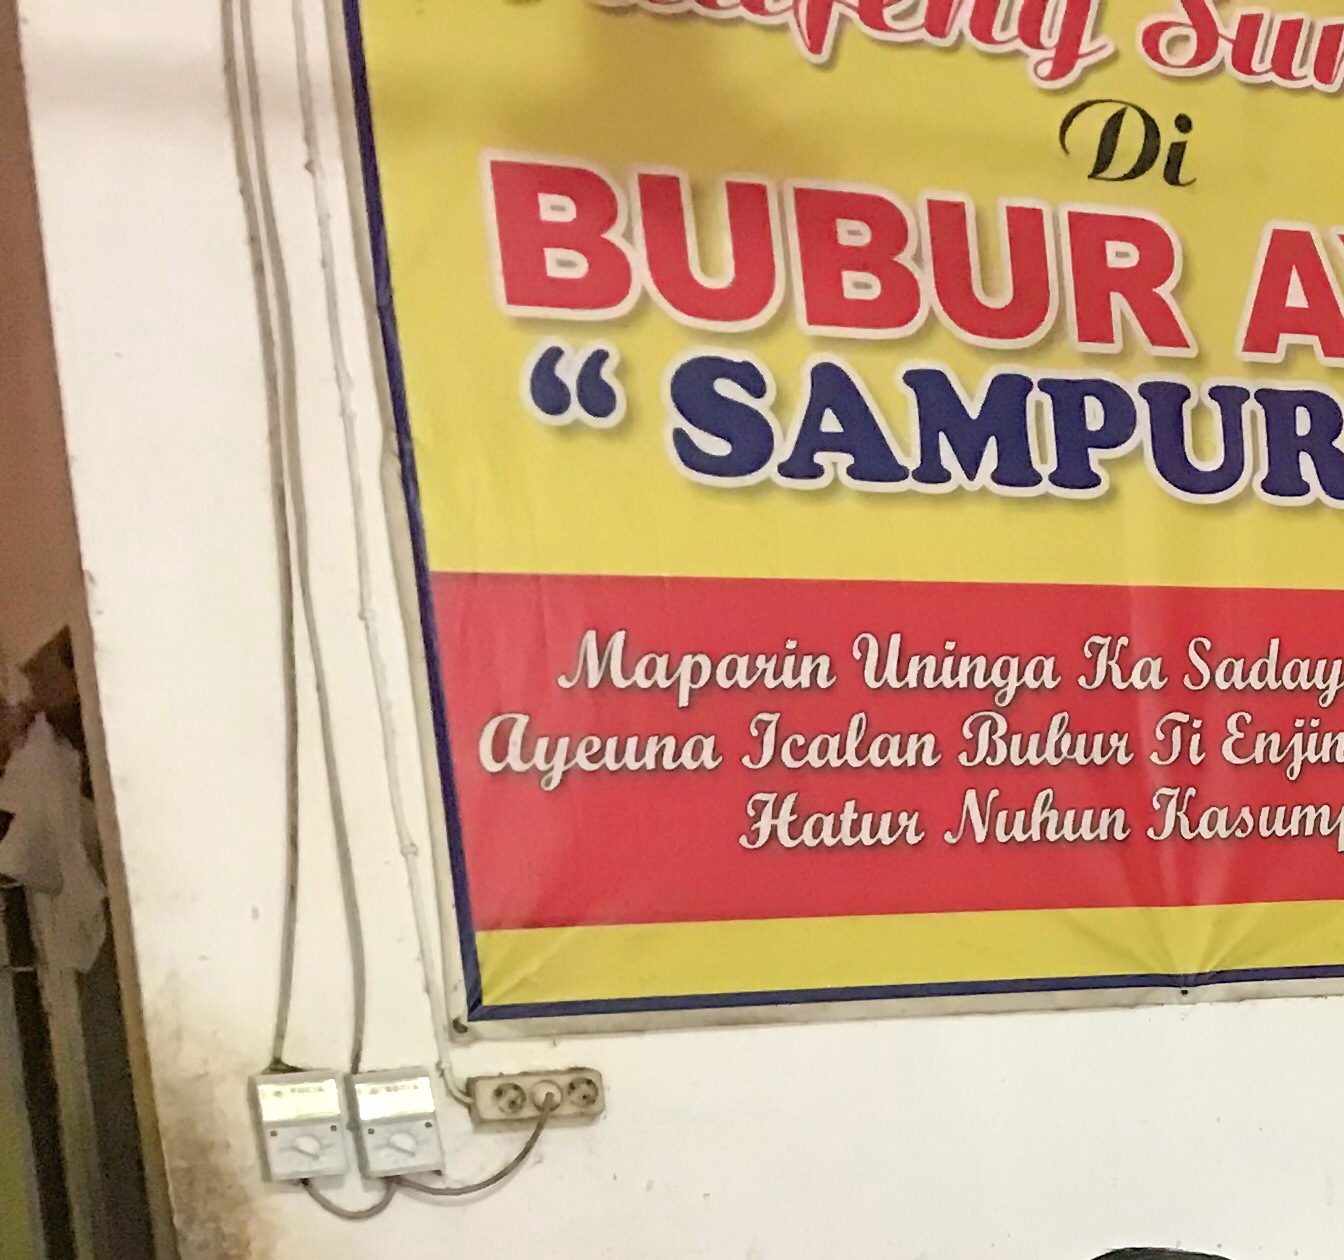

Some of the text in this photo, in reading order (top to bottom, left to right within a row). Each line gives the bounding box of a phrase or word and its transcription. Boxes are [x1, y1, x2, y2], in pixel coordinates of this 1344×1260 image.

[1059, 99, 1195, 188] Di
[489, 159, 1191, 351] BUBUR
[556, 629, 838, 705] Maparin
[851, 632, 1061, 708] Uninga
[1076, 634, 1169, 692] Ka
[477, 711, 719, 790] Ayeuna
[740, 711, 942, 771] Icalan
[956, 711, 1135, 768] Bubur
[1148, 711, 1207, 766] Ti
[738, 791, 926, 850] Hatur
[942, 787, 1132, 846] Nuhun
